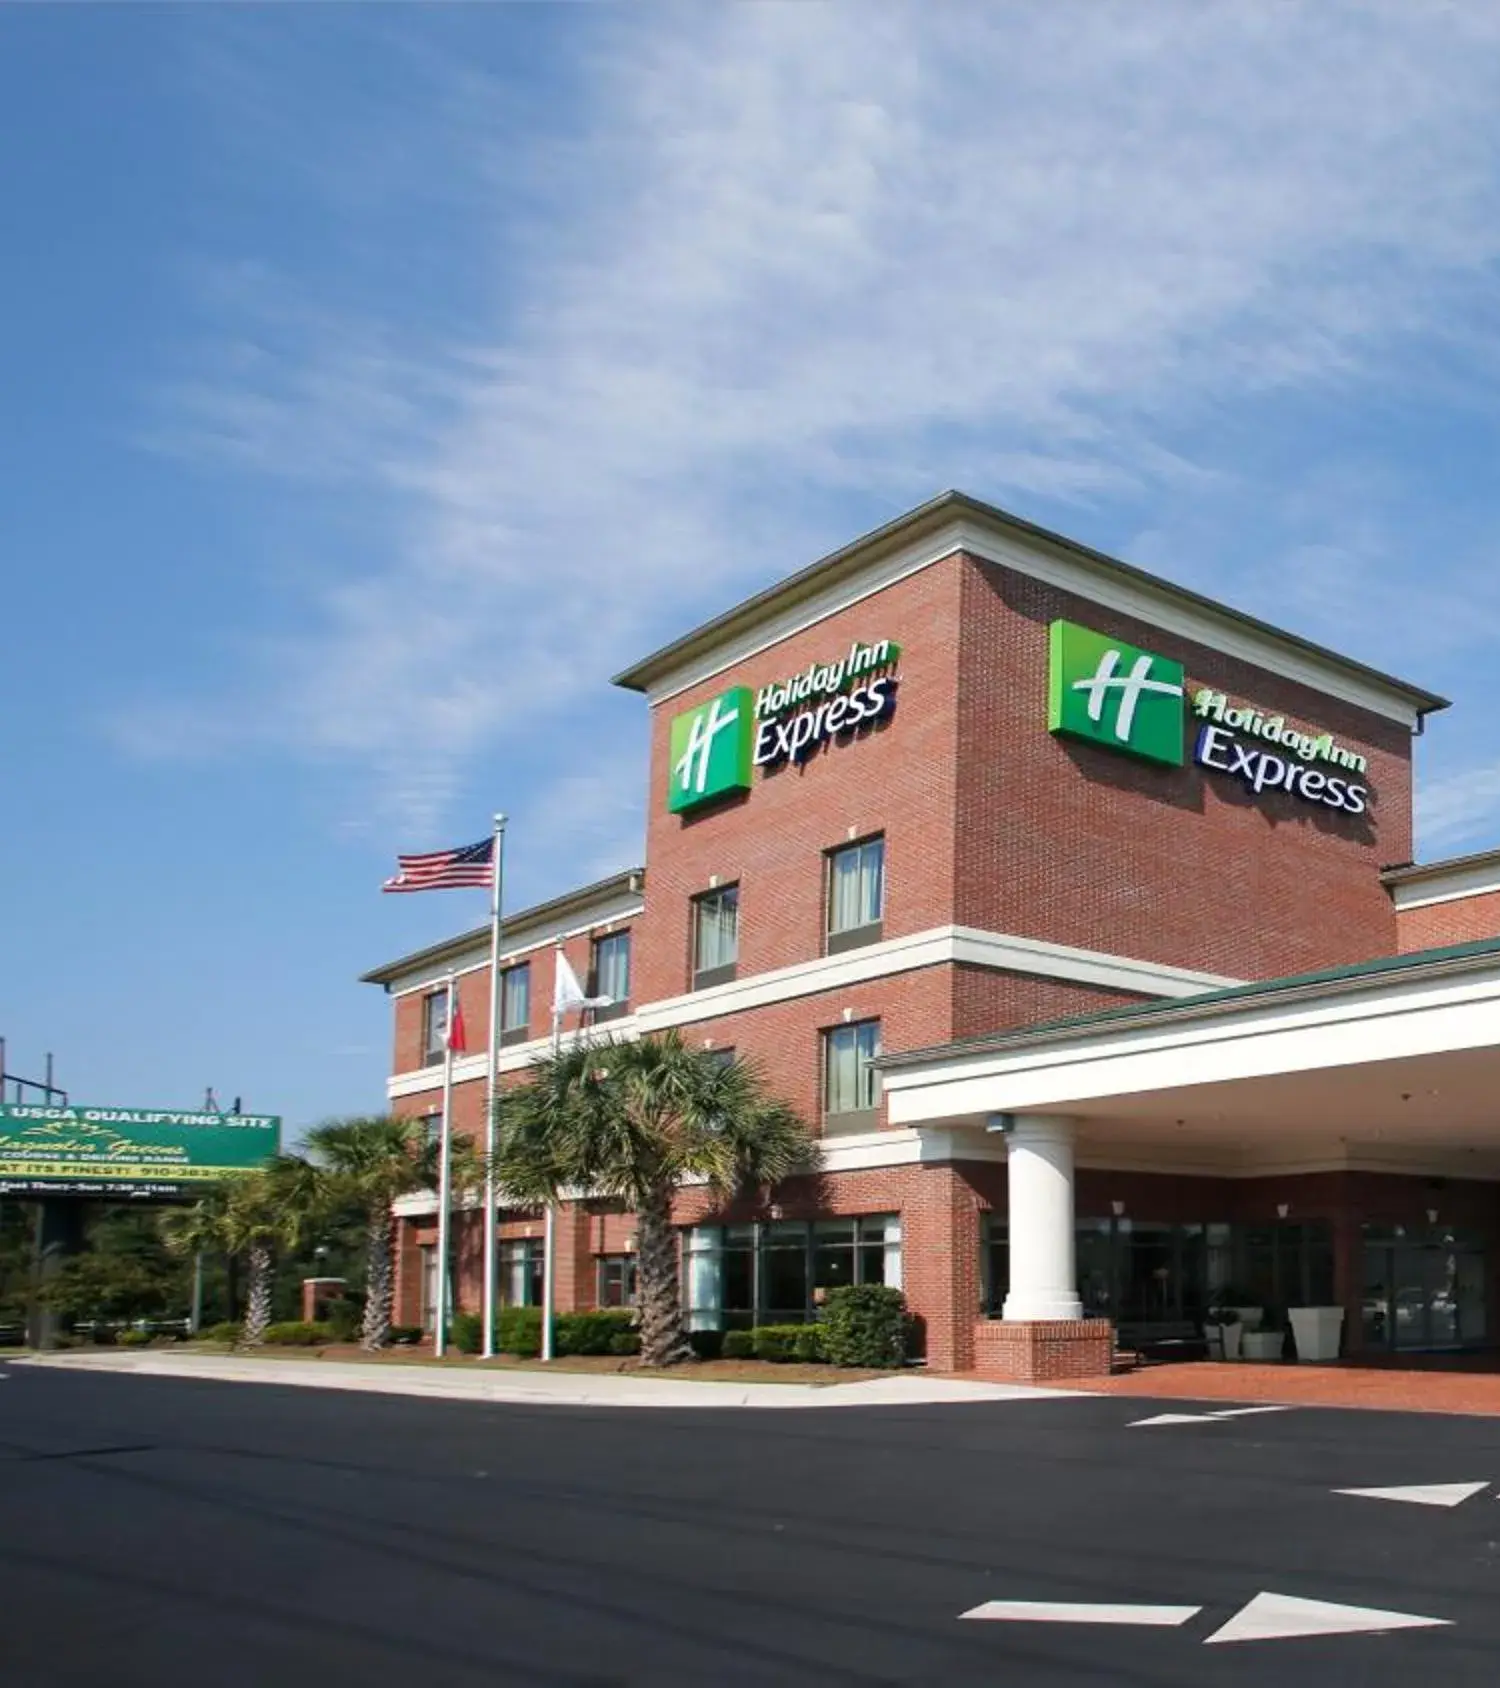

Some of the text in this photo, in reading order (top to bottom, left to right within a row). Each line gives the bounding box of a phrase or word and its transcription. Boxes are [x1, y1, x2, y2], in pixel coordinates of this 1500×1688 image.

[753, 678, 890, 765] Express
[755, 639, 892, 718] Holiday Inn
[1194, 688, 1368, 774] Holiday Inn
[1199, 725, 1369, 815] Express
[11, 1106, 78, 1120] USGA
[84, 1109, 220, 1126] QUALIFYING
[224, 1116, 273, 1129] SITE
